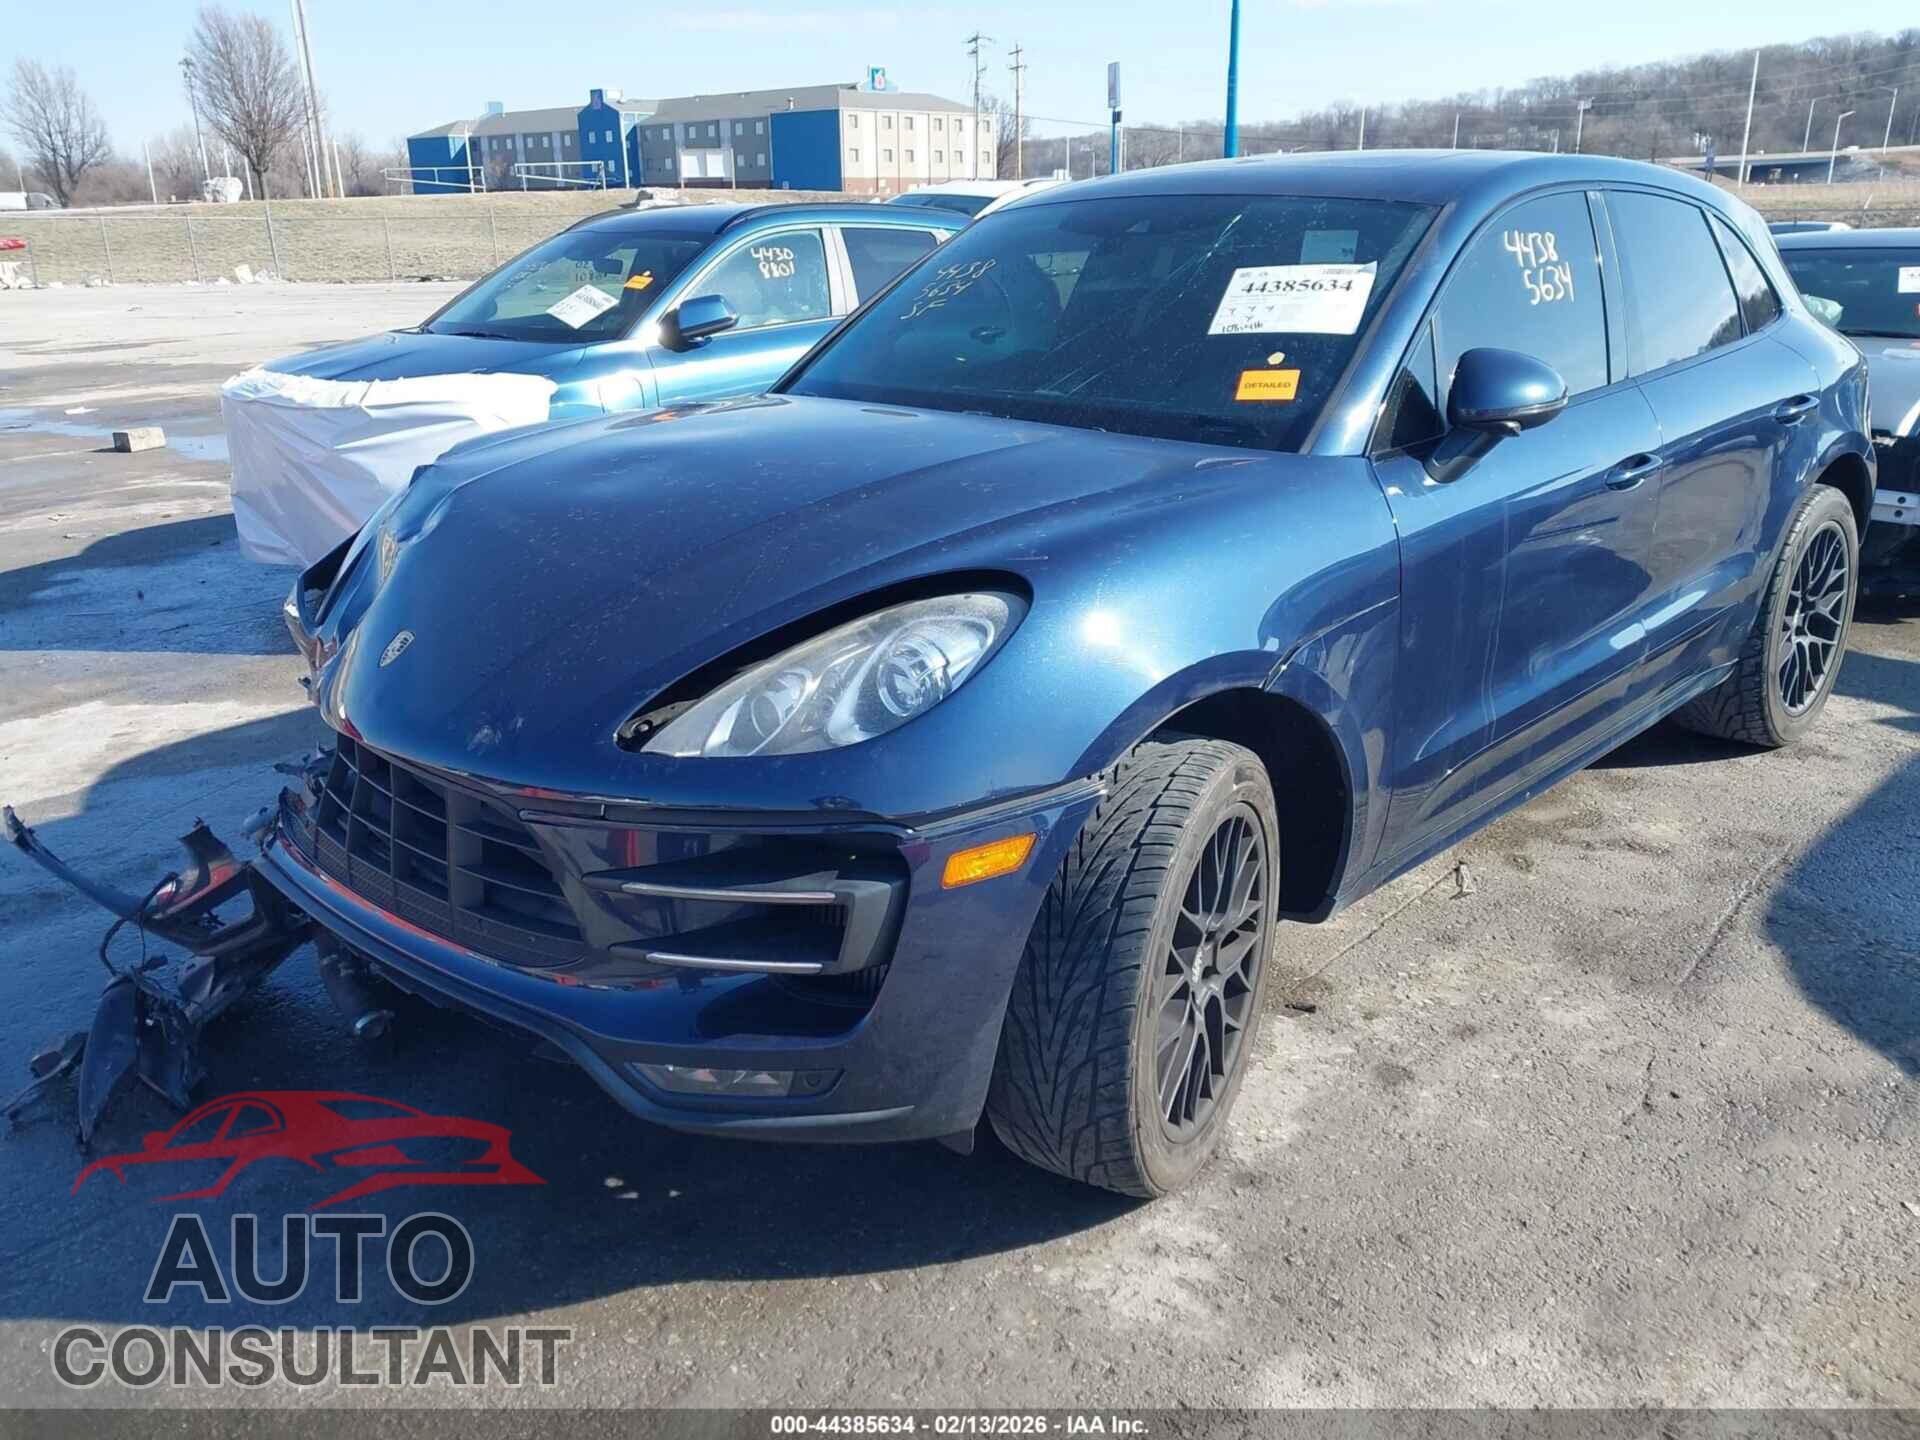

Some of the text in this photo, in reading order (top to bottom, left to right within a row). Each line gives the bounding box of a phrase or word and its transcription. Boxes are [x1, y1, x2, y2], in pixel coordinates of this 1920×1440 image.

[751, 247, 794, 261] 4430
[1504, 229, 1558, 267] 4438
[1241, 278, 1353, 294] 44385634
[1523, 261, 1574, 305] 5634
